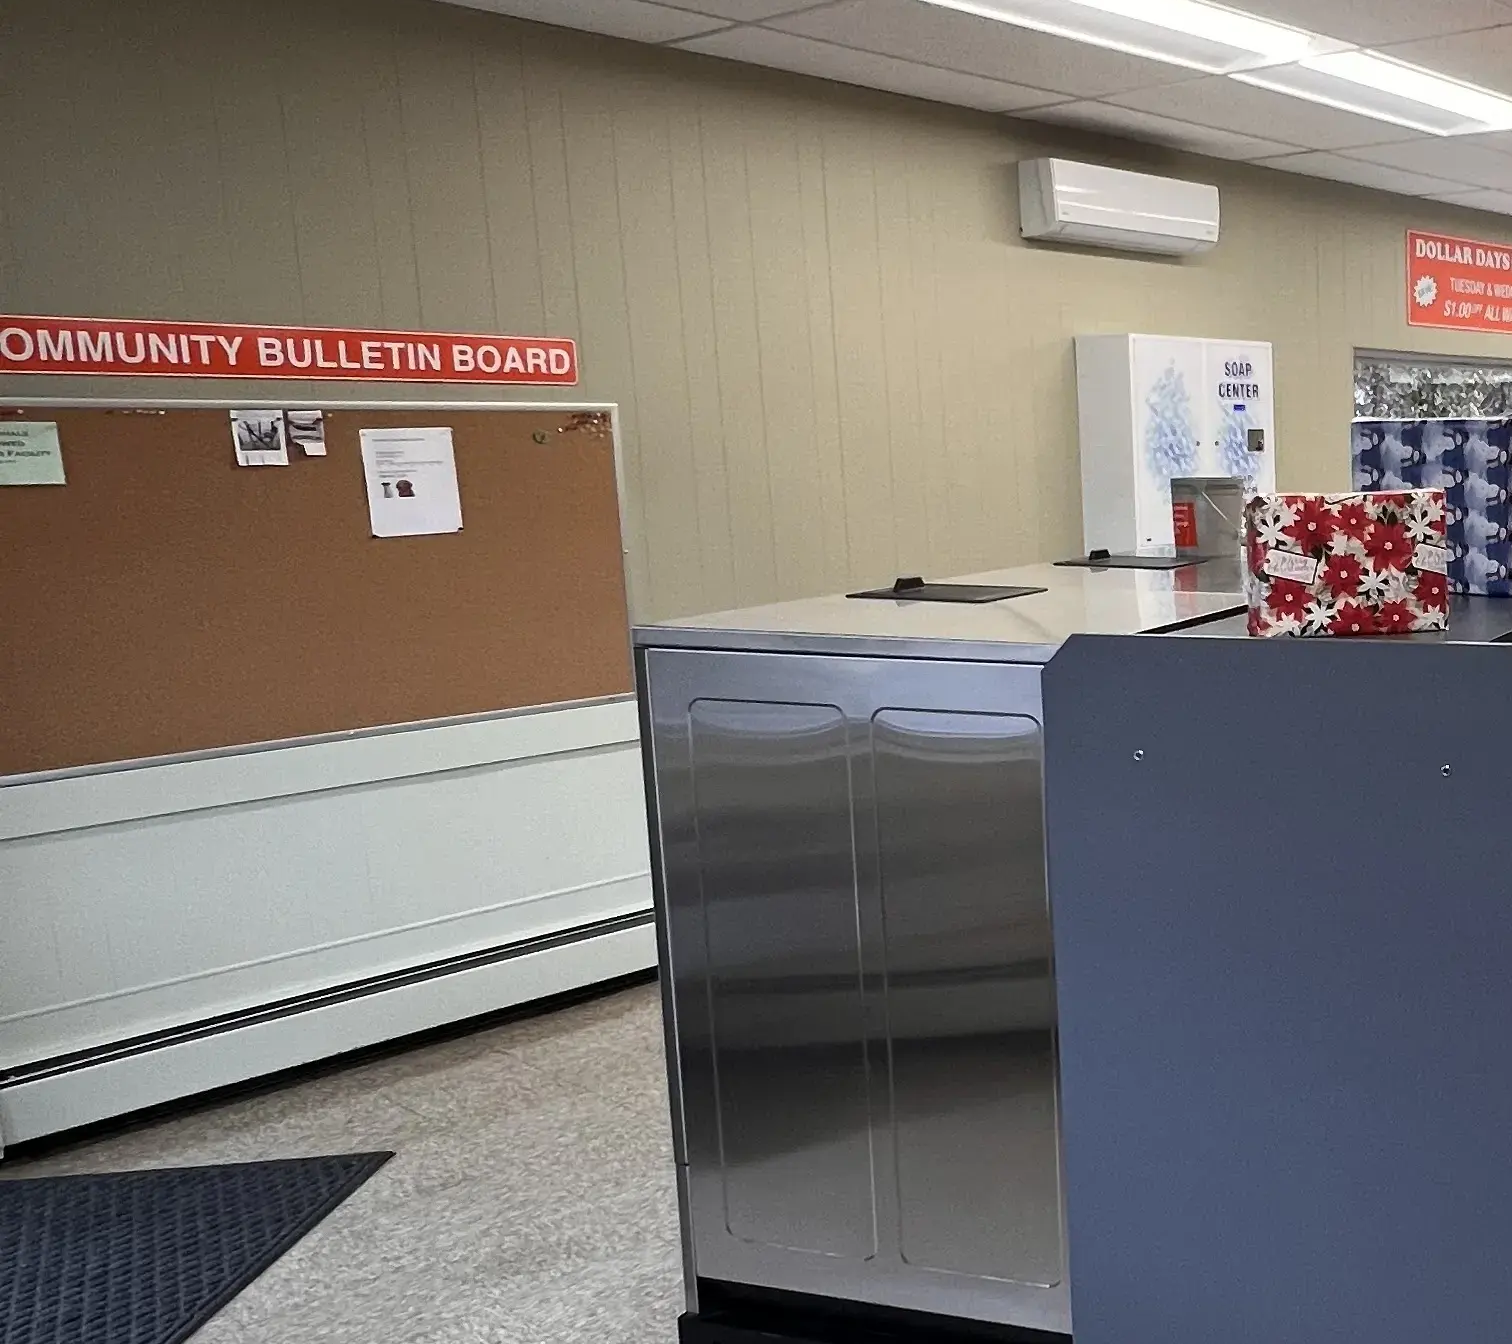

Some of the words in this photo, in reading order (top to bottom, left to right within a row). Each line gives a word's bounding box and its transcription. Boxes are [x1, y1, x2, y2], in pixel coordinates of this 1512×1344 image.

[1415, 238, 1473, 265] DOLLAR
[1475, 248, 1510, 271] DAYS
[1450, 277, 1485, 296] TUESDAY
[1487, 283, 1493, 297] &
[1484, 304, 1501, 322] ALL
[0, 327, 243, 366] OMMUNITY
[257, 336, 442, 371] BULLETIN
[452, 344, 570, 375] BOARD
[1224, 361, 1253, 377] SOAP
[1218, 383, 1259, 398] CENTER
